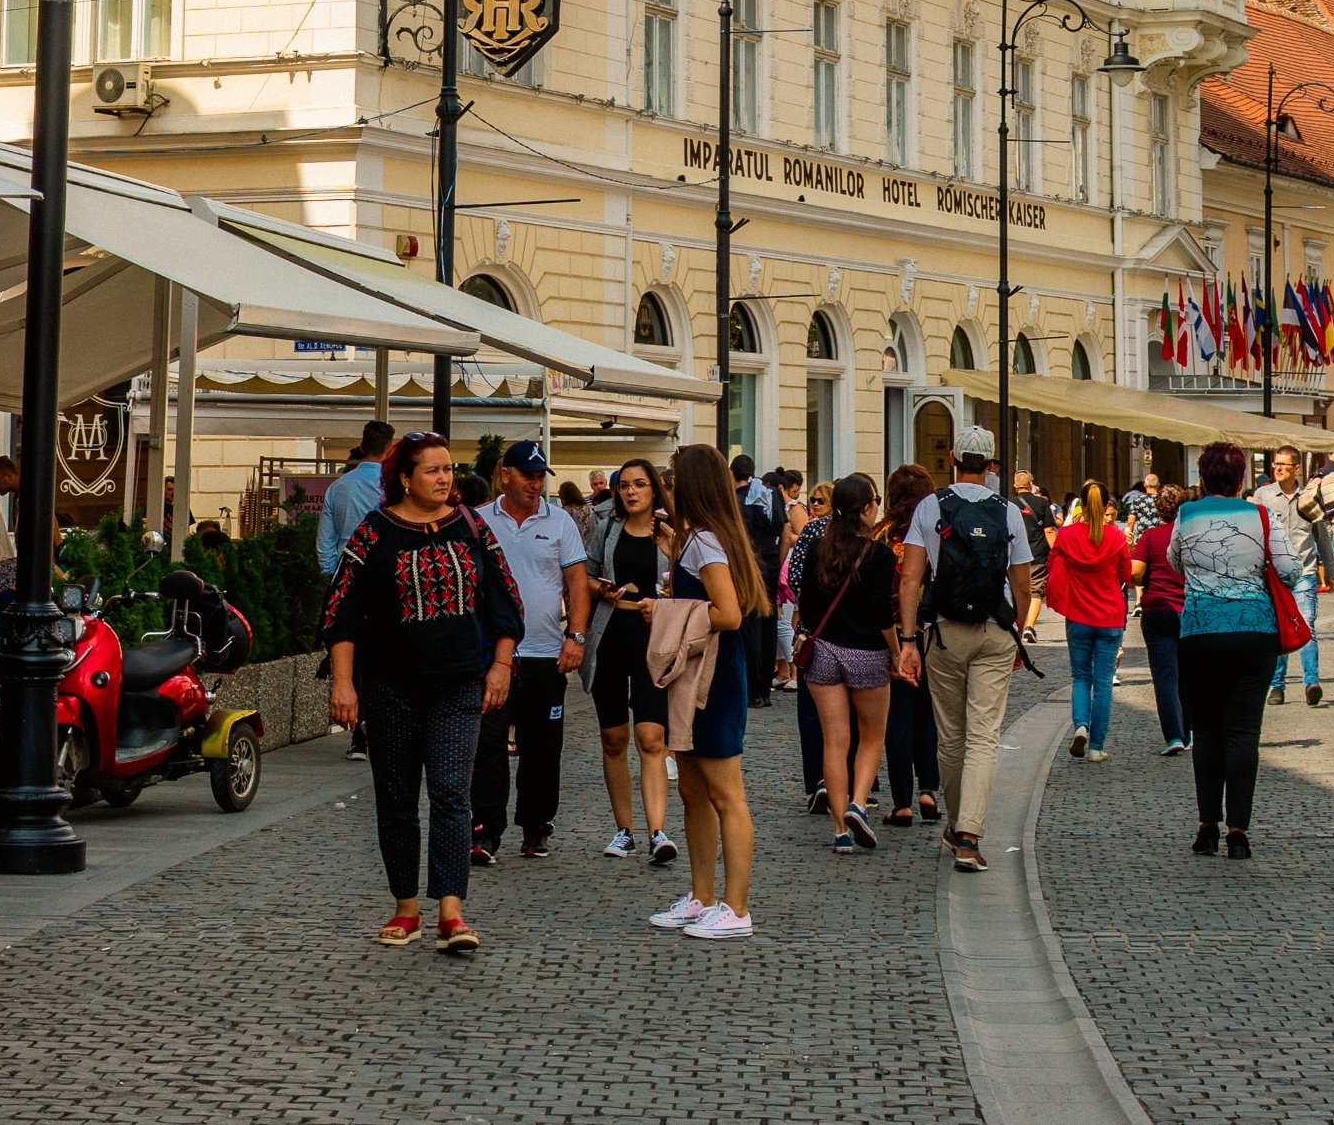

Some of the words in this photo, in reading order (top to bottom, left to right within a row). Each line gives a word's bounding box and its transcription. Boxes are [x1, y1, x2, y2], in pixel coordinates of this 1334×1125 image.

[783, 157, 865, 199] ROMANILOR
[882, 177, 921, 208] HOTEL
[1008, 200, 1046, 230] KAISER
